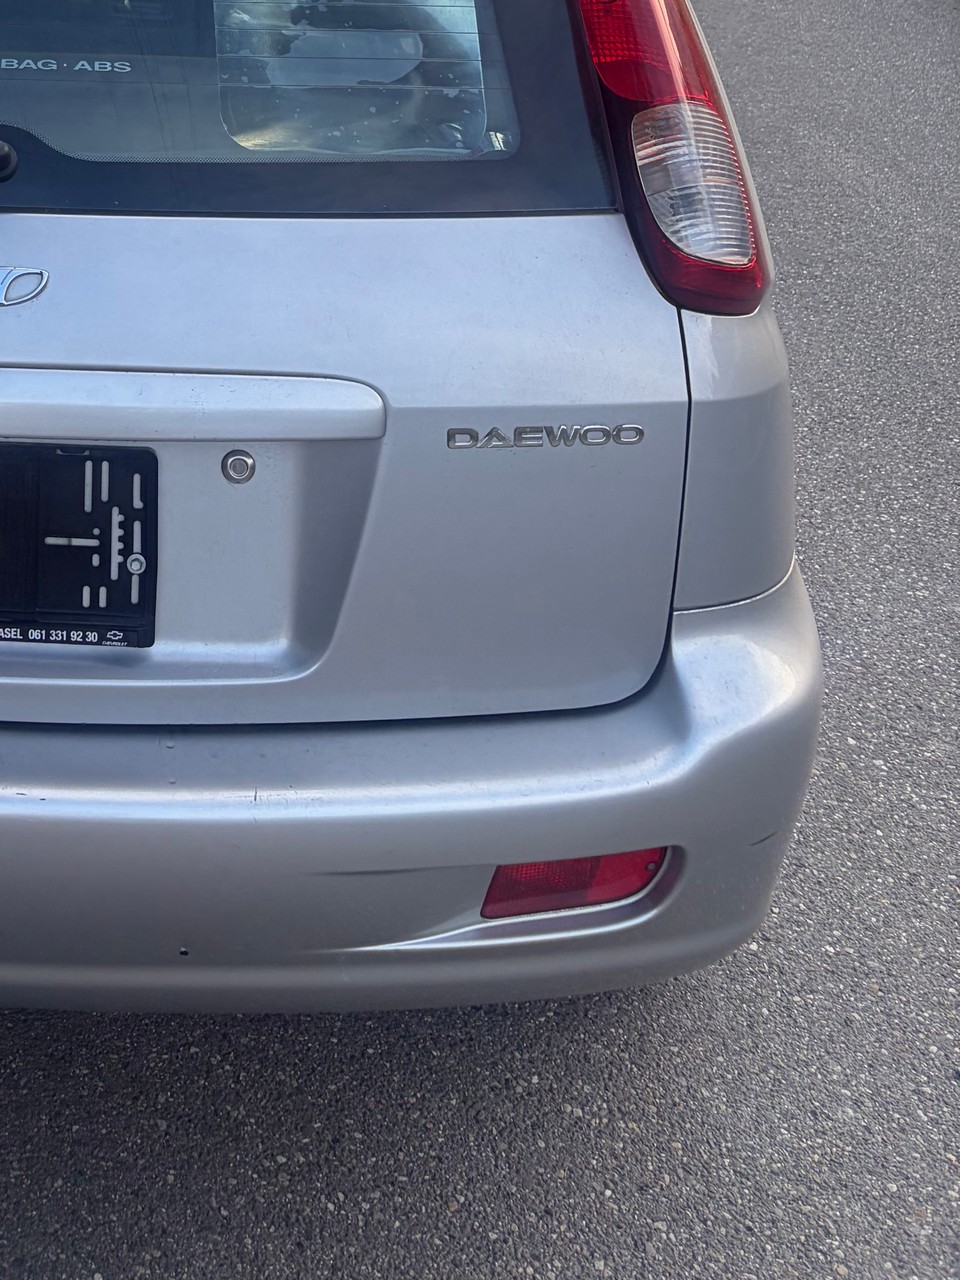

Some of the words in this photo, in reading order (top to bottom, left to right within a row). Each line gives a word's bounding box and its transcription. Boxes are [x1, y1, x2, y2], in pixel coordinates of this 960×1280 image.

[0, 58, 58, 70] BAG
[73, 60, 132, 73] ABS
[446, 424, 645, 450] DAEWOO
[28, 629, 46, 640] 061
[49, 630, 67, 641] 331
[70, 631, 83, 642] 92
[85, 632, 98, 643] 30
